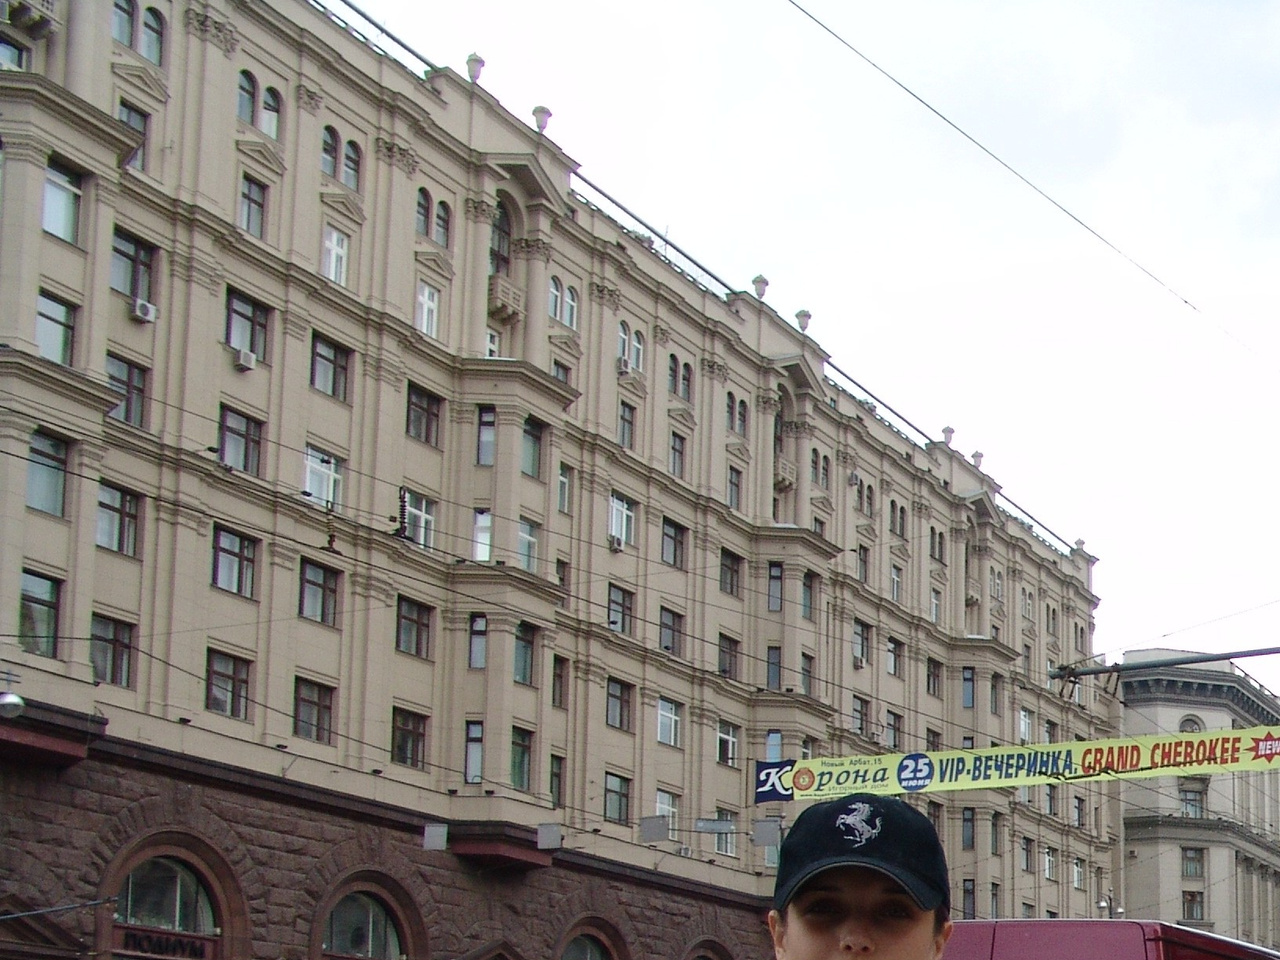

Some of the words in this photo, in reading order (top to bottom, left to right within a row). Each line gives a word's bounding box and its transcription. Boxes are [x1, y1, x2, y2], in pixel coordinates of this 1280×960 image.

[820, 759, 845, 767] Новый
[1082, 744, 1141, 775] GRAND
[1150, 737, 1242, 769] CHEROKEE
[901, 758, 930, 779] 25
